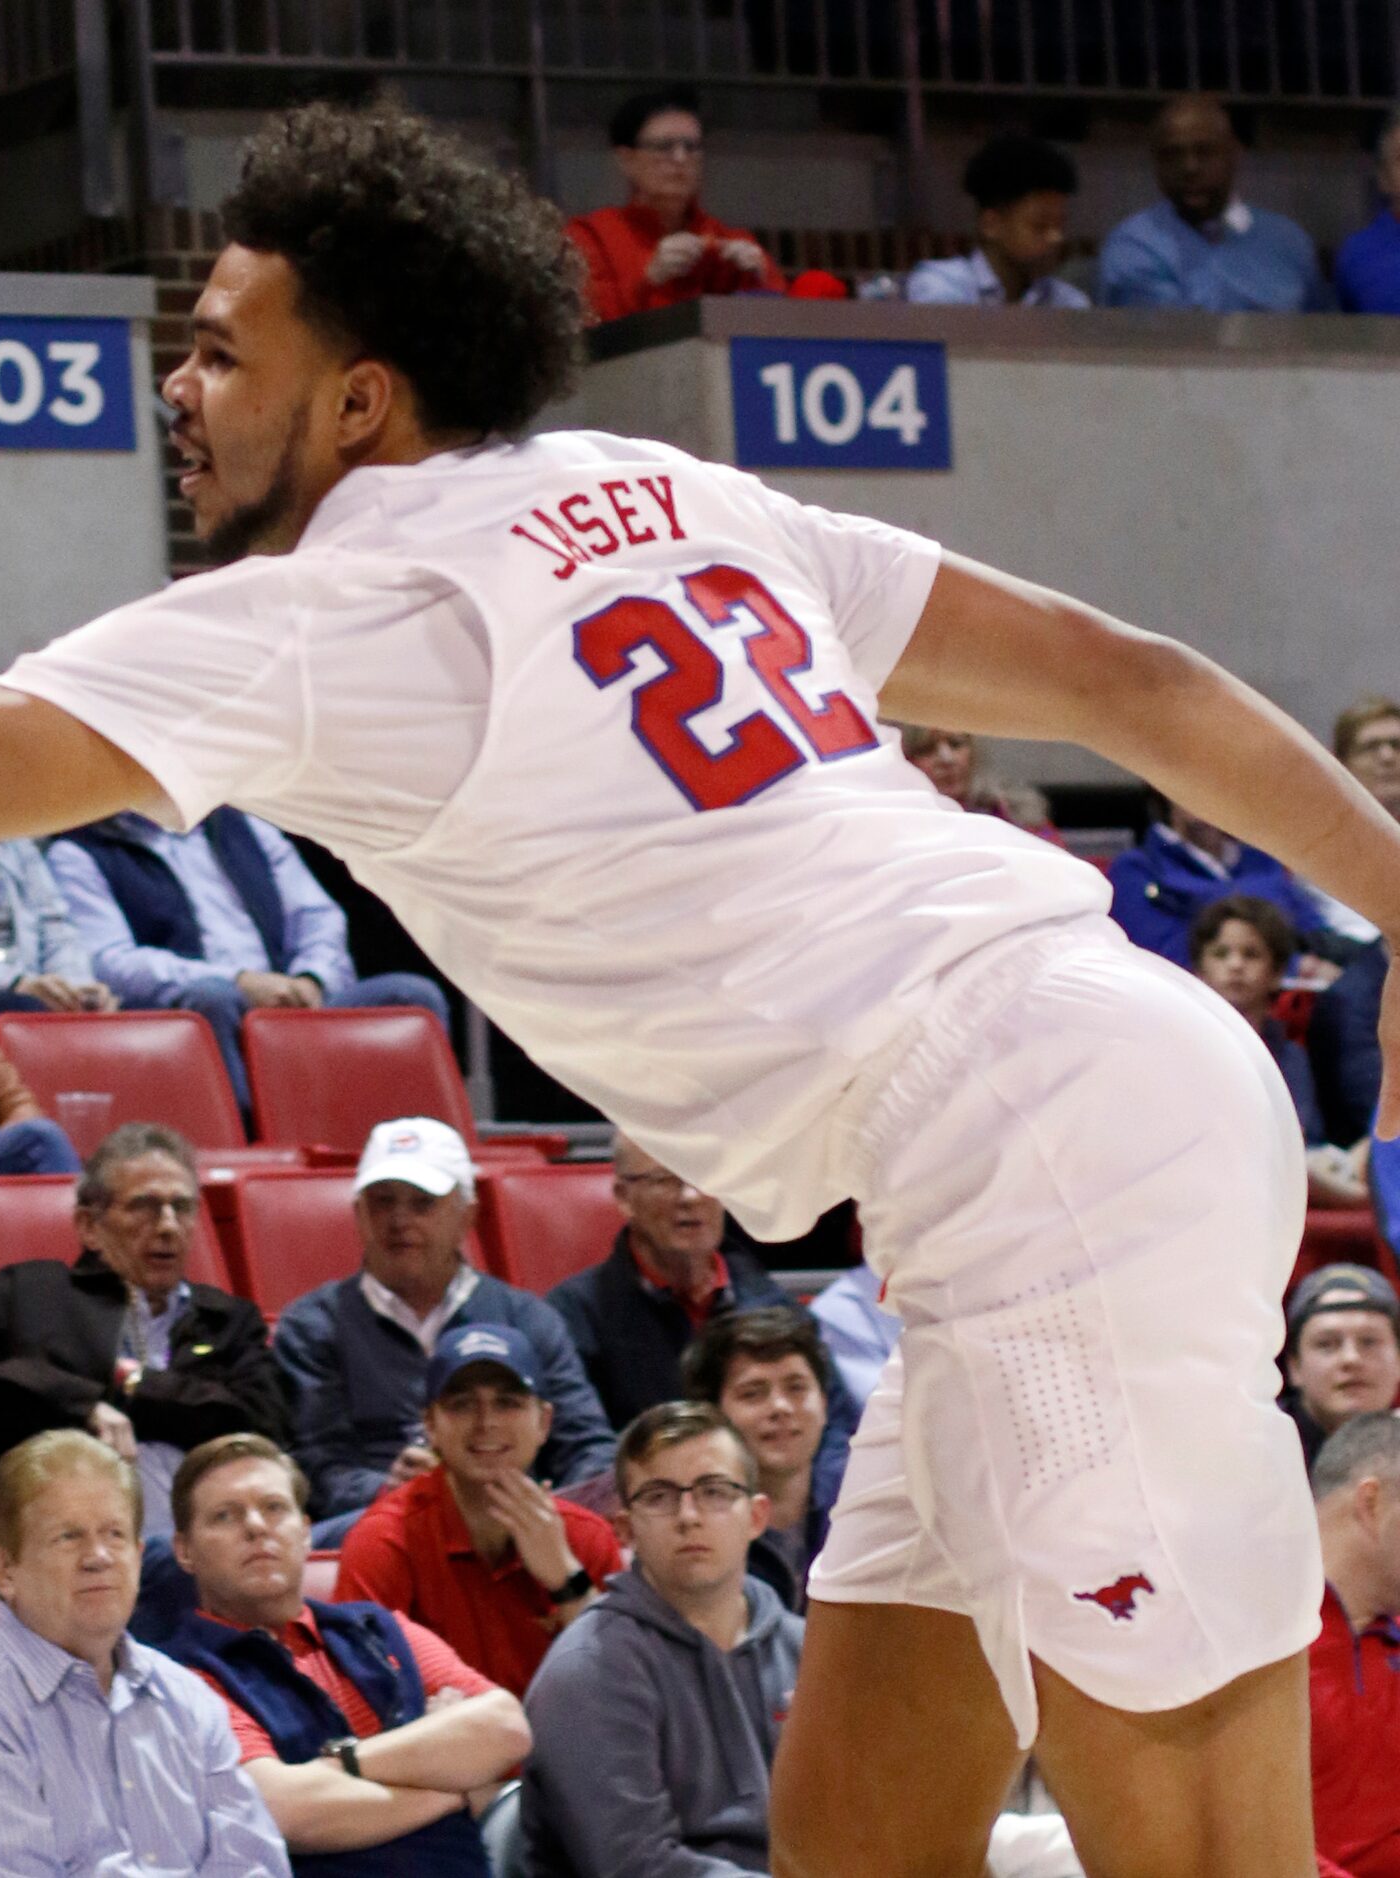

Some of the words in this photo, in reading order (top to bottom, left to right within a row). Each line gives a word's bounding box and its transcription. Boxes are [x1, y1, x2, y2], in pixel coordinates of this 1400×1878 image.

[760, 362, 928, 446] 104
[510, 475, 688, 580] JASEY
[572, 563, 881, 813] 22
